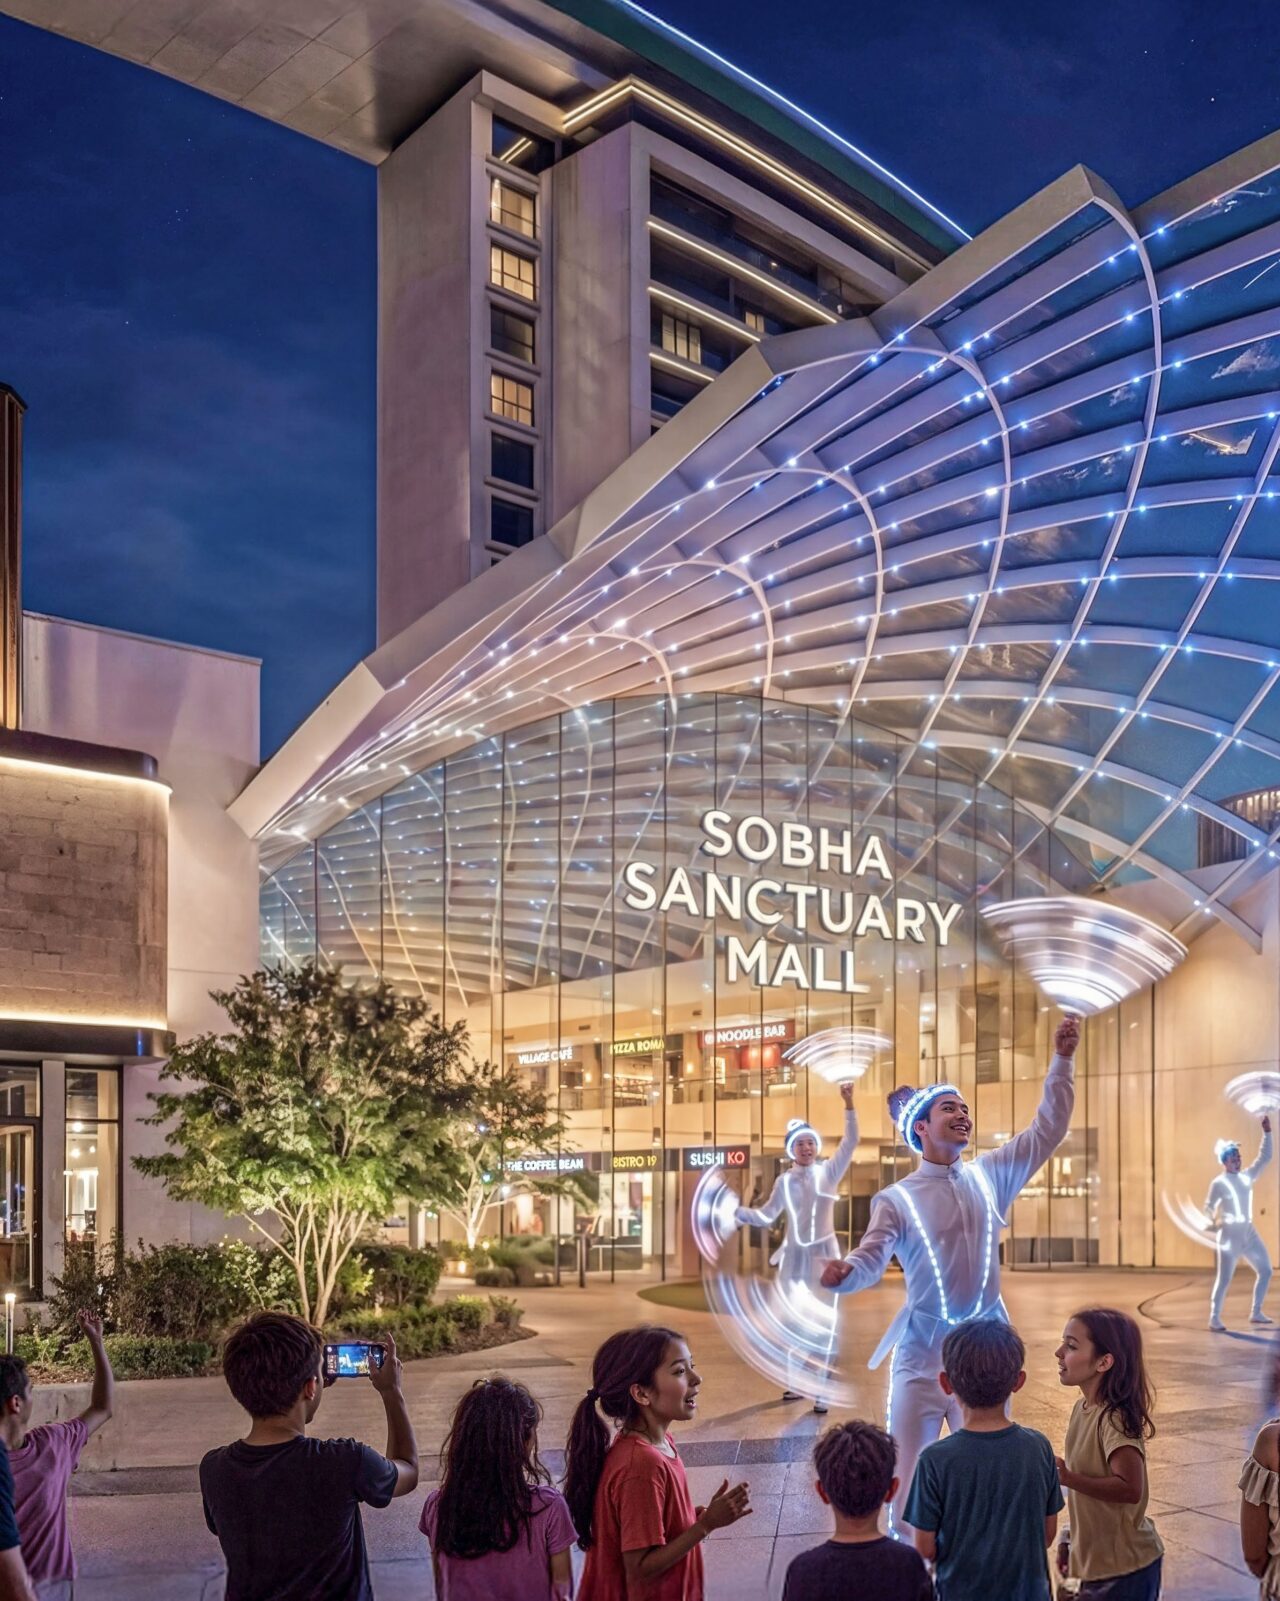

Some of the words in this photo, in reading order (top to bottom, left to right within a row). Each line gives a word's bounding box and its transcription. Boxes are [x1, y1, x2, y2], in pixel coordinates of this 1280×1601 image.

[702, 810, 893, 880] SOBHA
[624, 862, 962, 946] SANCTUARY
[725, 936, 870, 994] MALL
[716, 1027, 761, 1042] NOODLE
[763, 1024, 786, 1037] BAR
[610, 1043, 635, 1055] PIZZA
[637, 1039, 664, 1051] ROMA
[518, 1052, 550, 1065] VILLAGE
[506, 1160, 523, 1171] THE
[524, 1159, 556, 1171] COFFEE
[558, 1158, 584, 1170] BEAN
[613, 1156, 644, 1168] BISTRO
[646, 1155, 657, 1167] 19
[690, 1151, 725, 1166] SUSHI
[727, 1151, 745, 1164] KO
